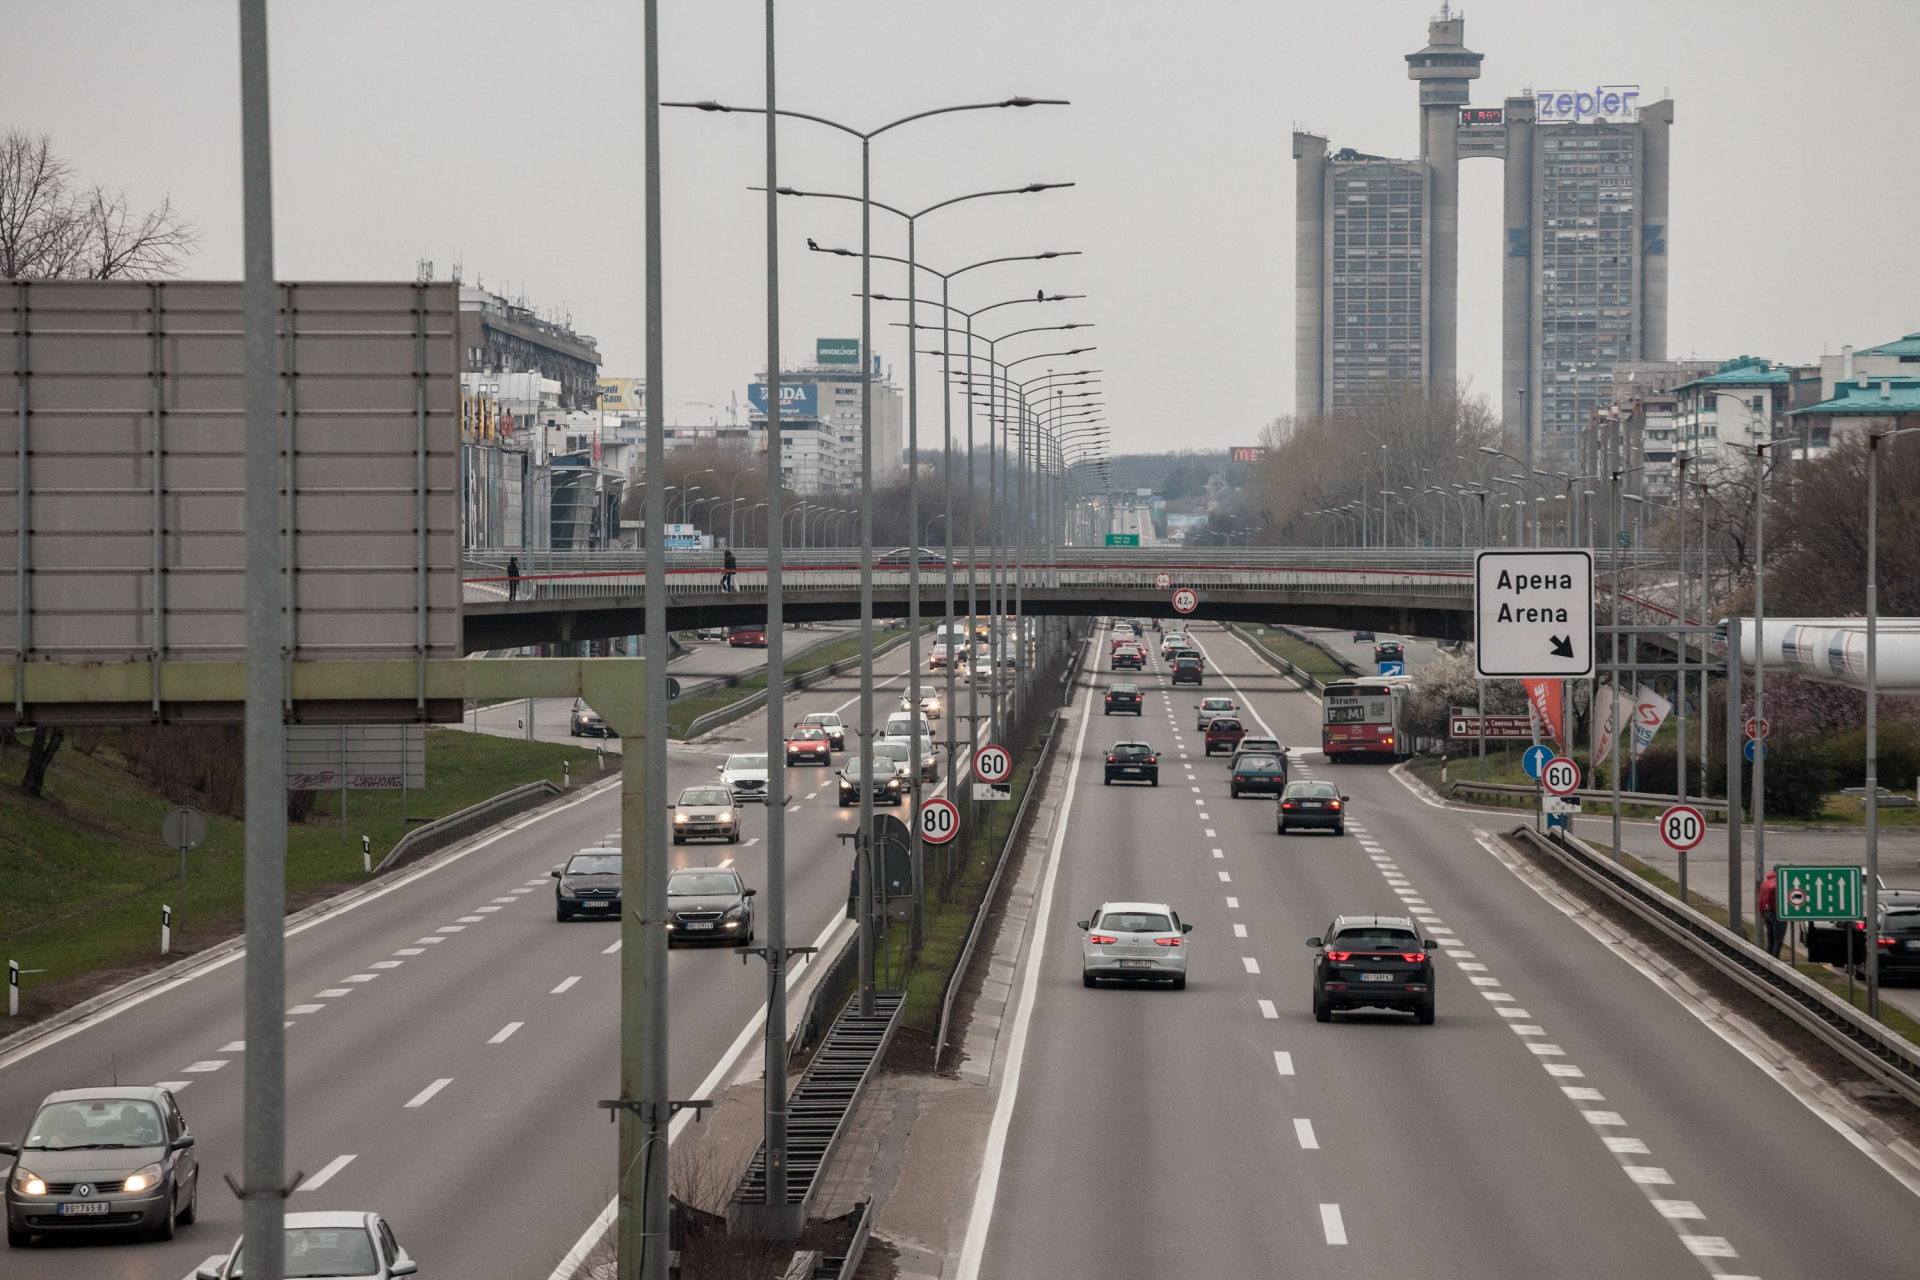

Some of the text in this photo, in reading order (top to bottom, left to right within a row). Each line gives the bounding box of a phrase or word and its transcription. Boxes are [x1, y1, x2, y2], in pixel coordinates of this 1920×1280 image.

[1537, 86, 1640, 121] zepter
[603, 394, 622, 403] Sam
[1496, 569, 1572, 595] Арена
[1497, 602, 1568, 623] Arena
[1330, 697, 1358, 705] Biram
[981, 754, 1004, 774] 60
[1549, 767, 1572, 786] 60
[924, 809, 951, 832] 80
[1668, 816, 1696, 840] 80
[65, 1204, 75, 1213] BG
